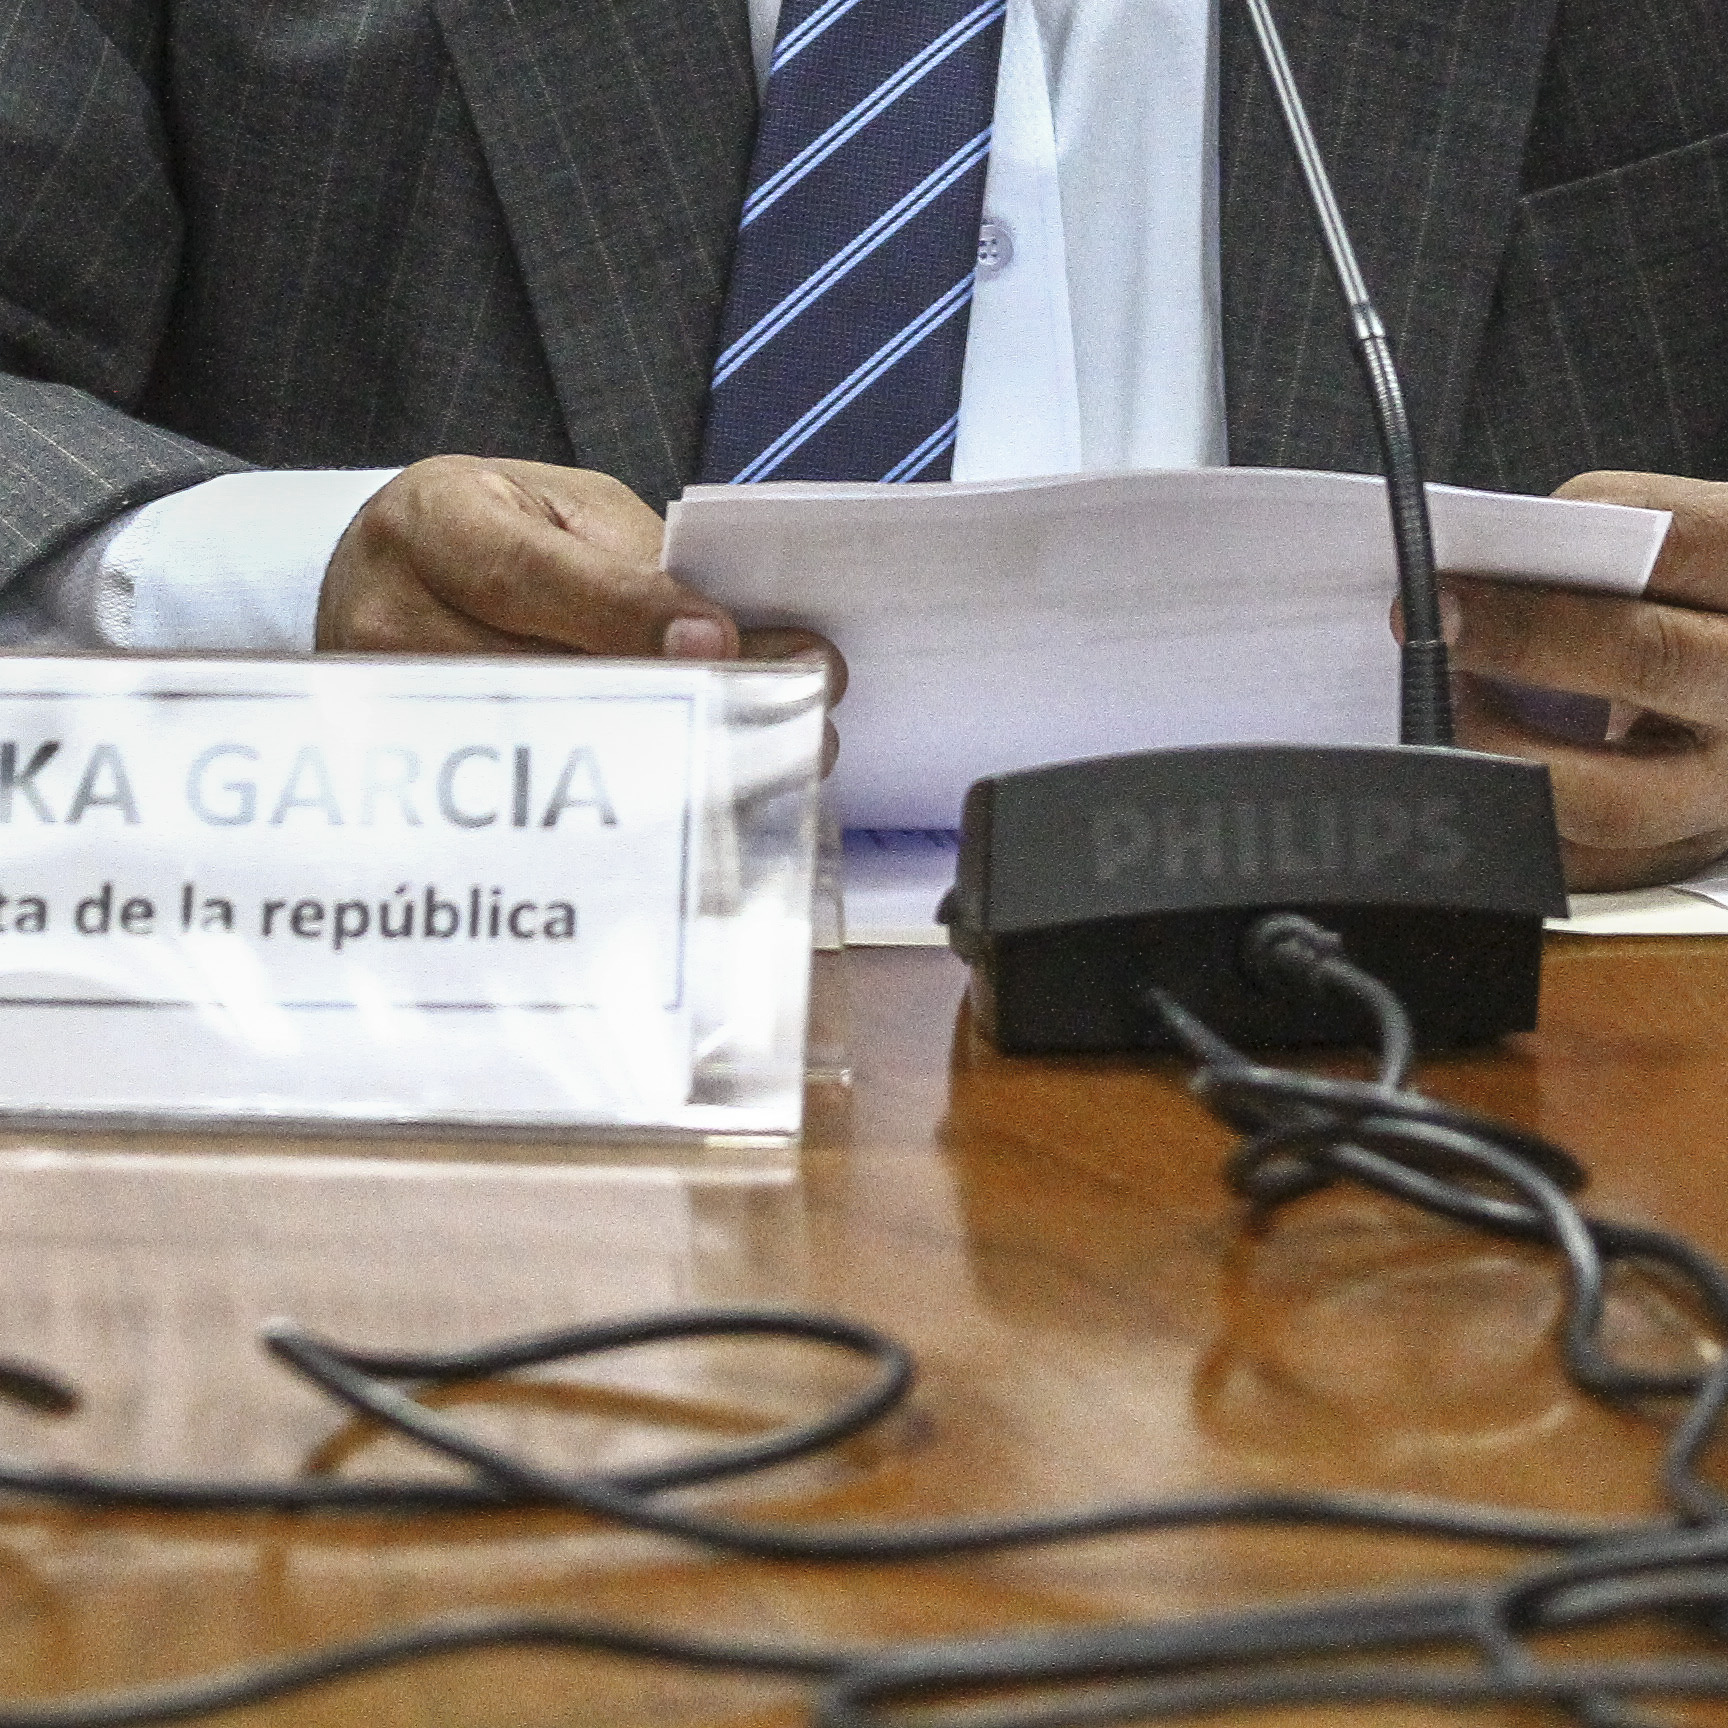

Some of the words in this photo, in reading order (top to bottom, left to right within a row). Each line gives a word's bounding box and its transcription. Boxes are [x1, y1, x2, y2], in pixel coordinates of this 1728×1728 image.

[185, 742, 620, 829] GARCIA
[1091, 796, 1470, 881] PHILIPS
[74, 883, 155, 936] de
[181, 882, 235, 934] la
[260, 883, 577, 951] república
